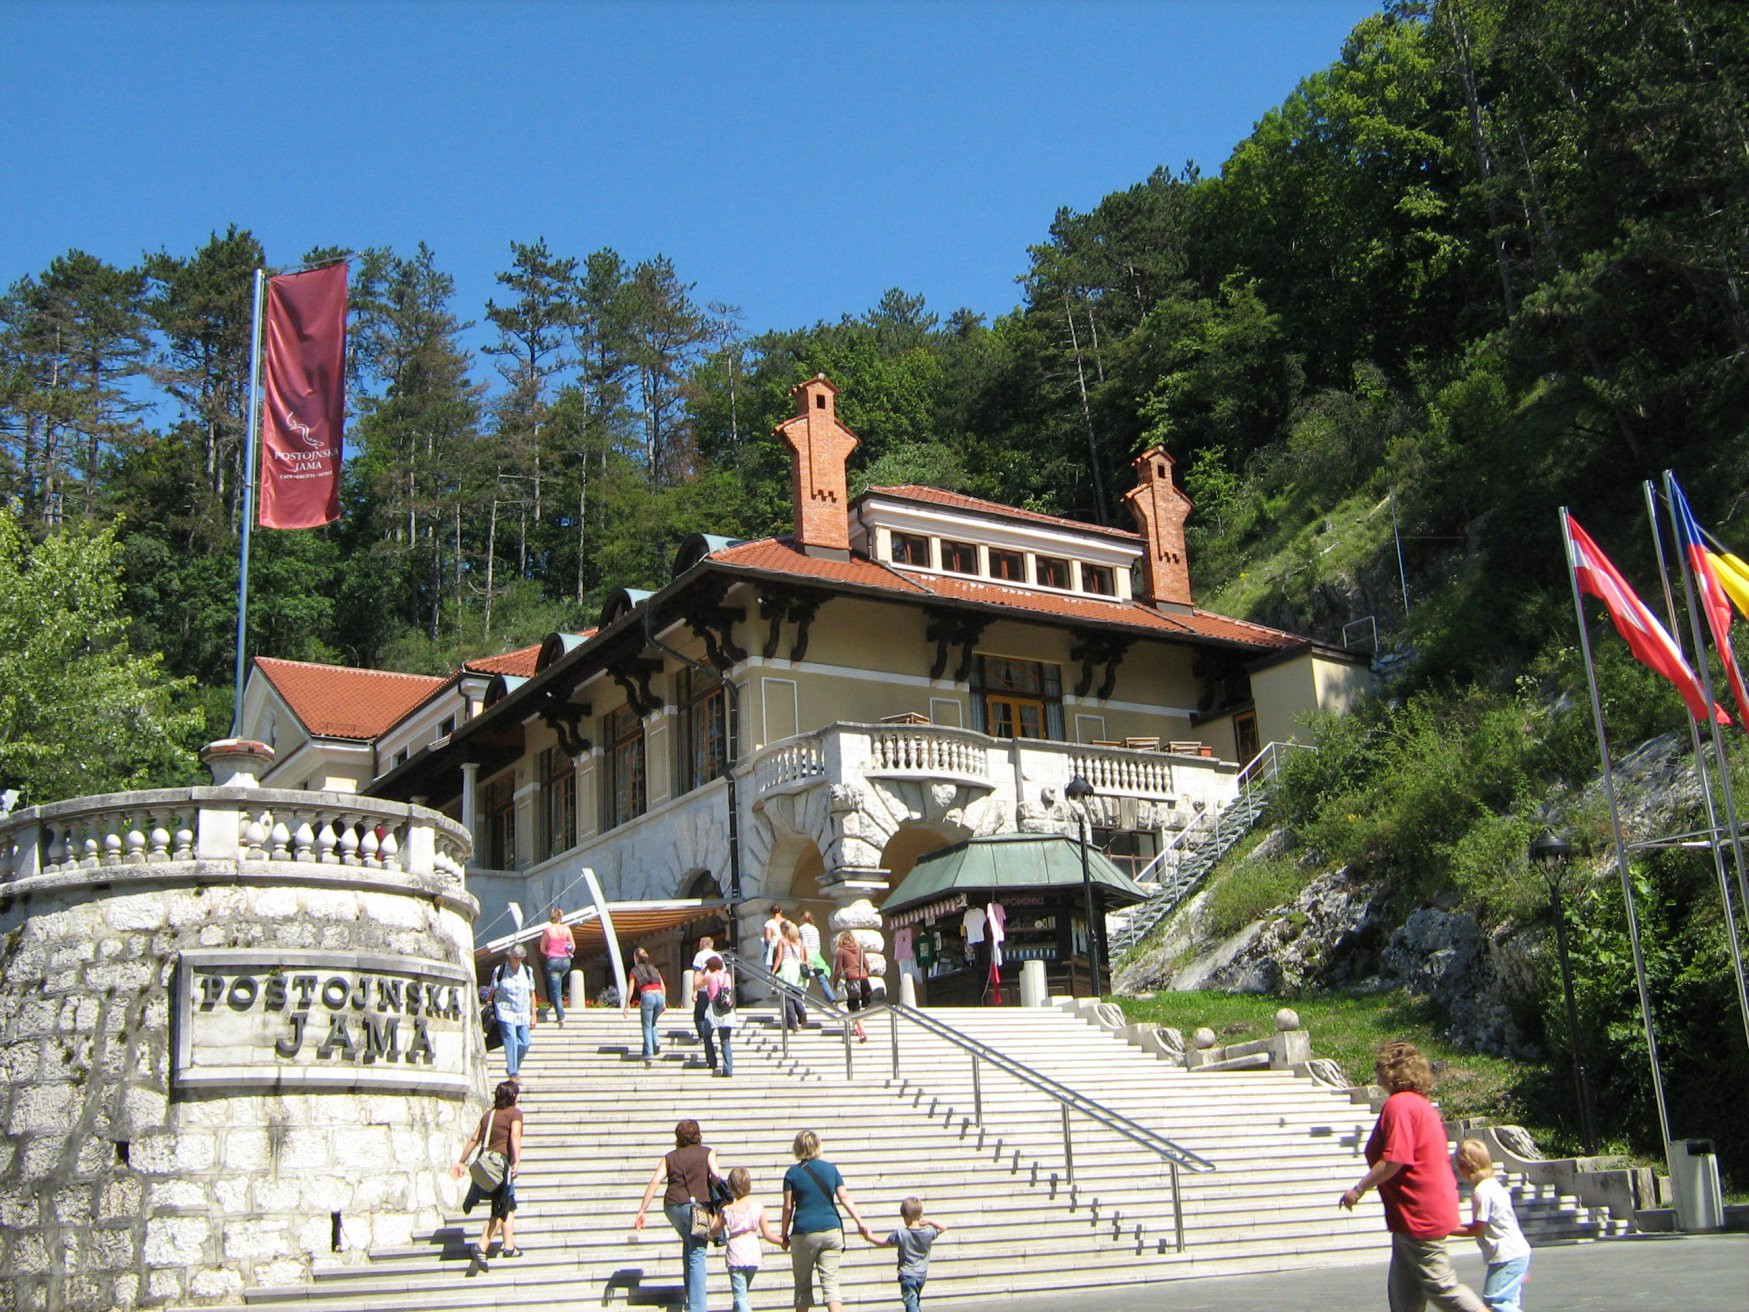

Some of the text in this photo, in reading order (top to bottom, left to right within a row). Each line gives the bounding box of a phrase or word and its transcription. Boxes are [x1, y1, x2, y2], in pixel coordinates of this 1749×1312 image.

[275, 448, 338, 461] POSTOJNSKA
[294, 462, 322, 472] JAMA
[200, 974, 462, 1021] POSTOJNSKA
[275, 1012, 437, 1065] JAMA
